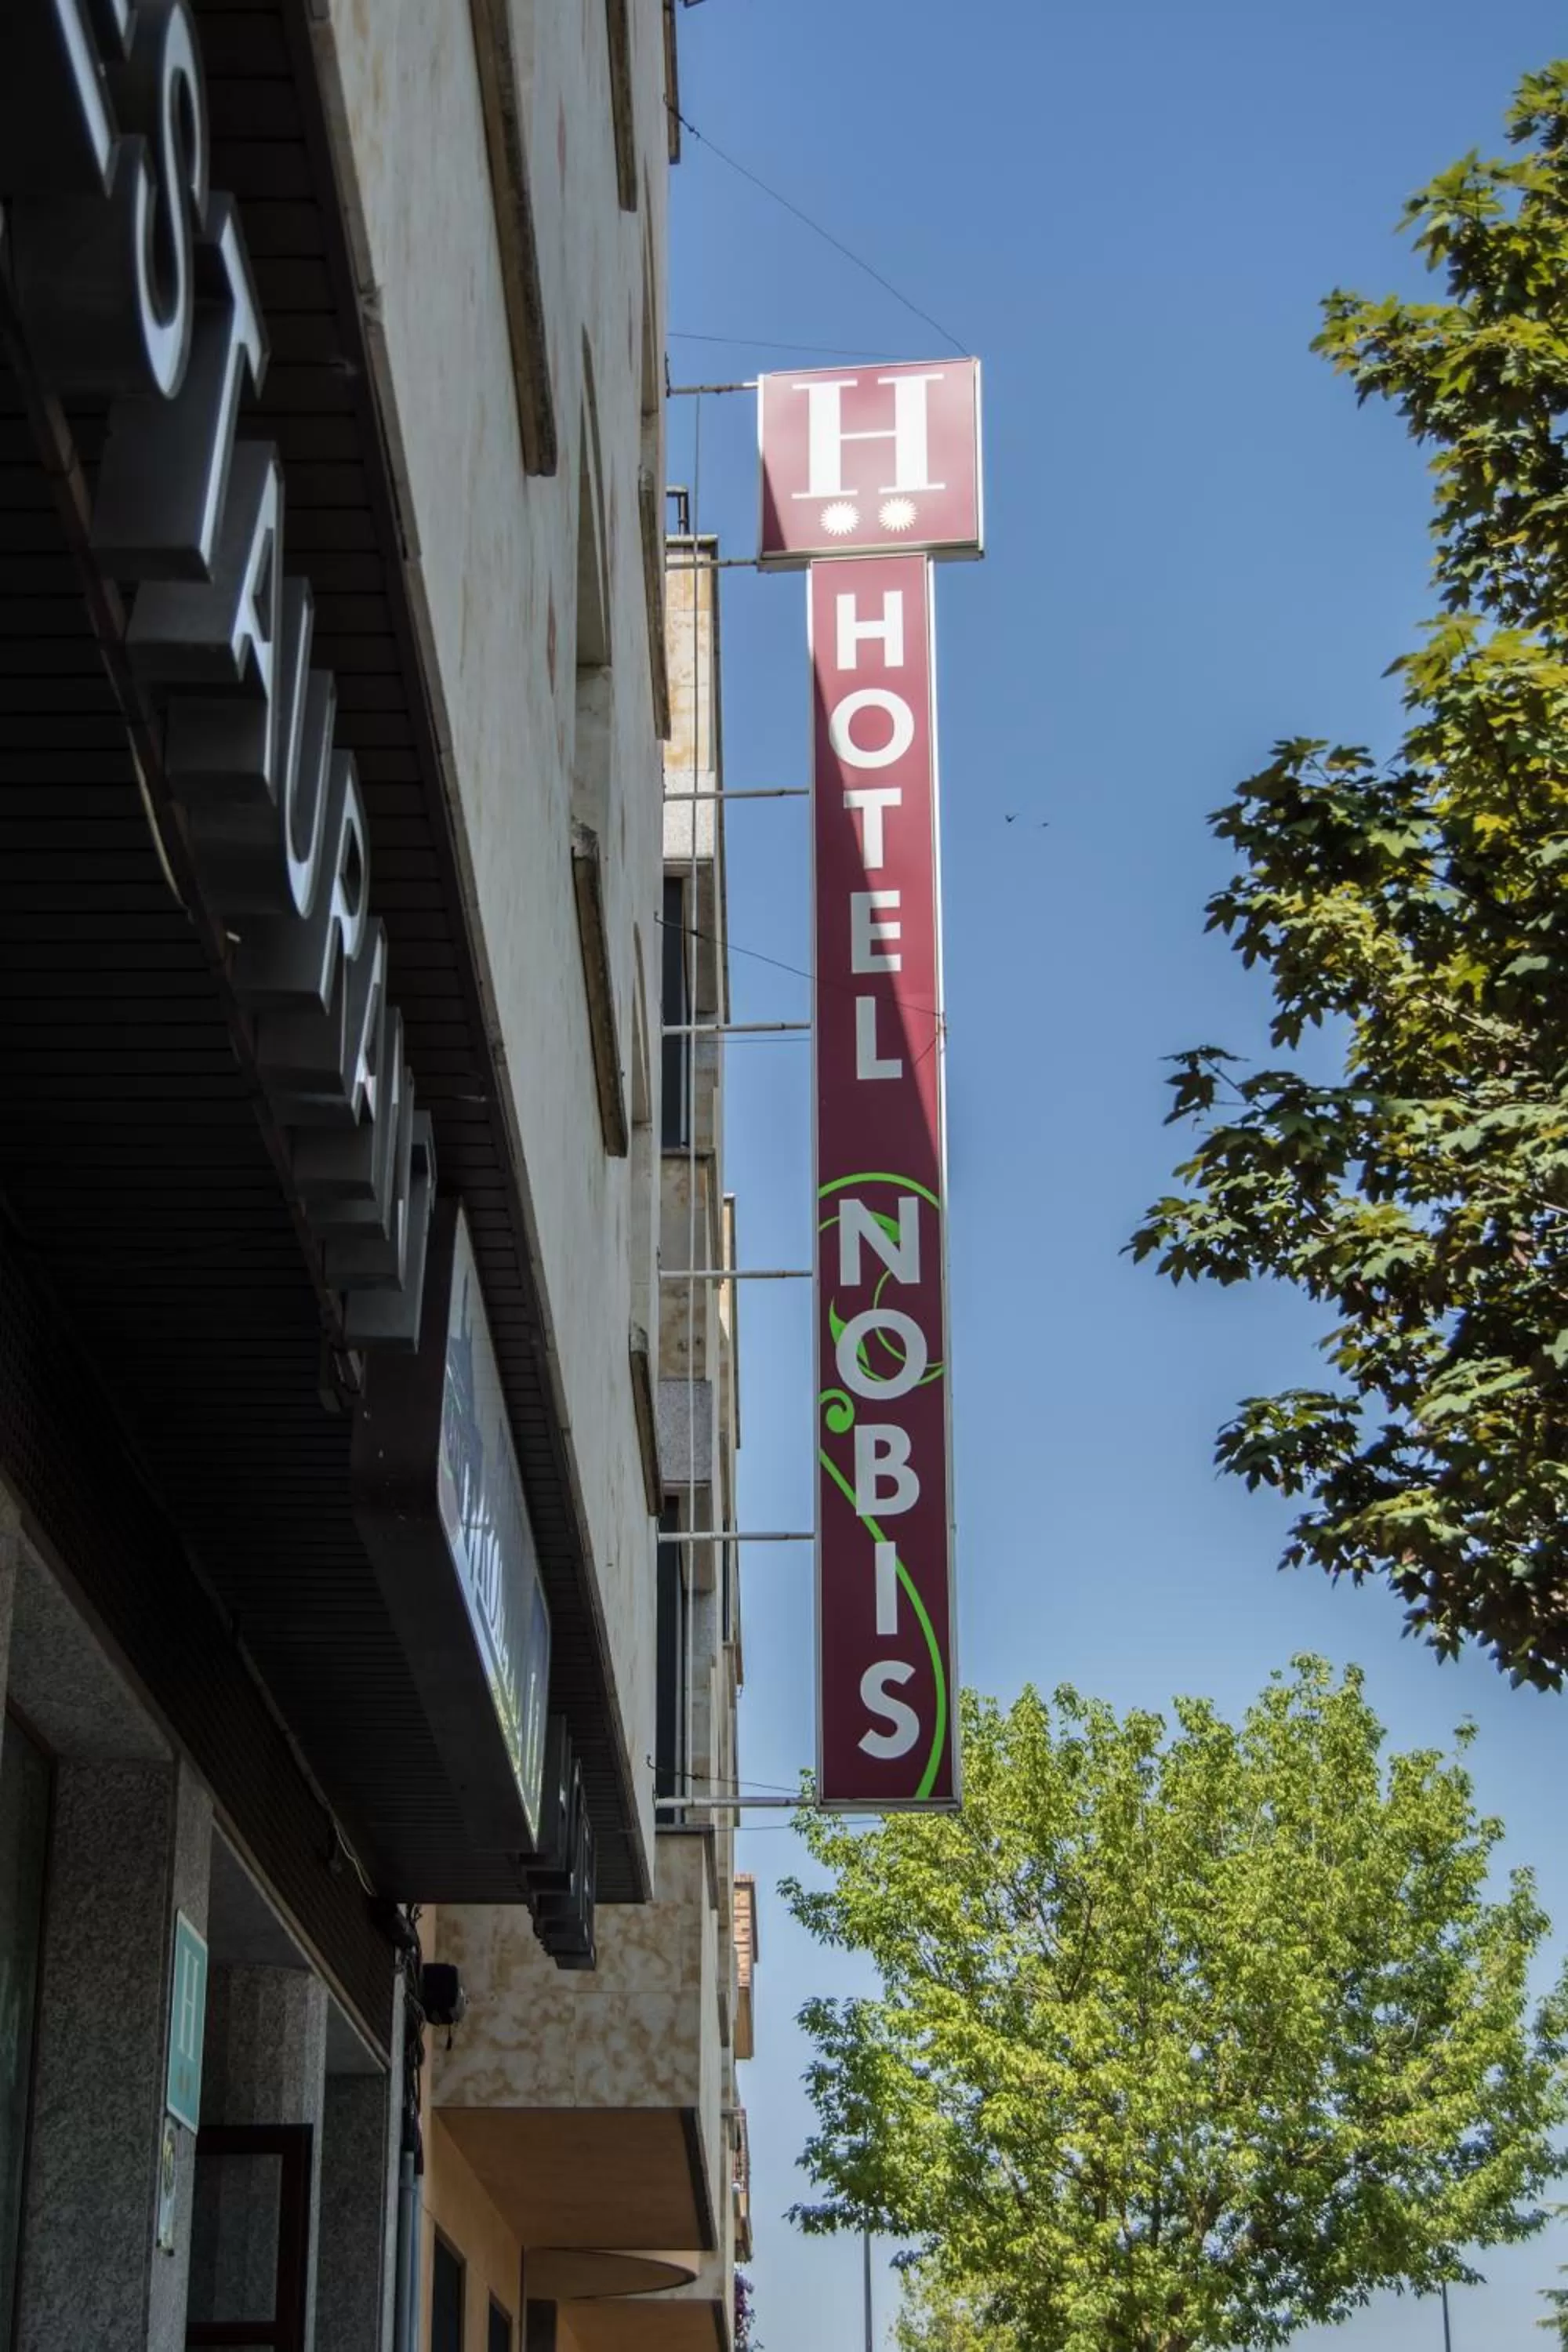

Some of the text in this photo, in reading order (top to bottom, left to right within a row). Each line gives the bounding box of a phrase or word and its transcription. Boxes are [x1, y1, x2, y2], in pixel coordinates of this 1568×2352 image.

[791, 373, 946, 500] H
[829, 590, 928, 1760] HOTEL NOBIS
[178, 1946, 199, 2061] H
